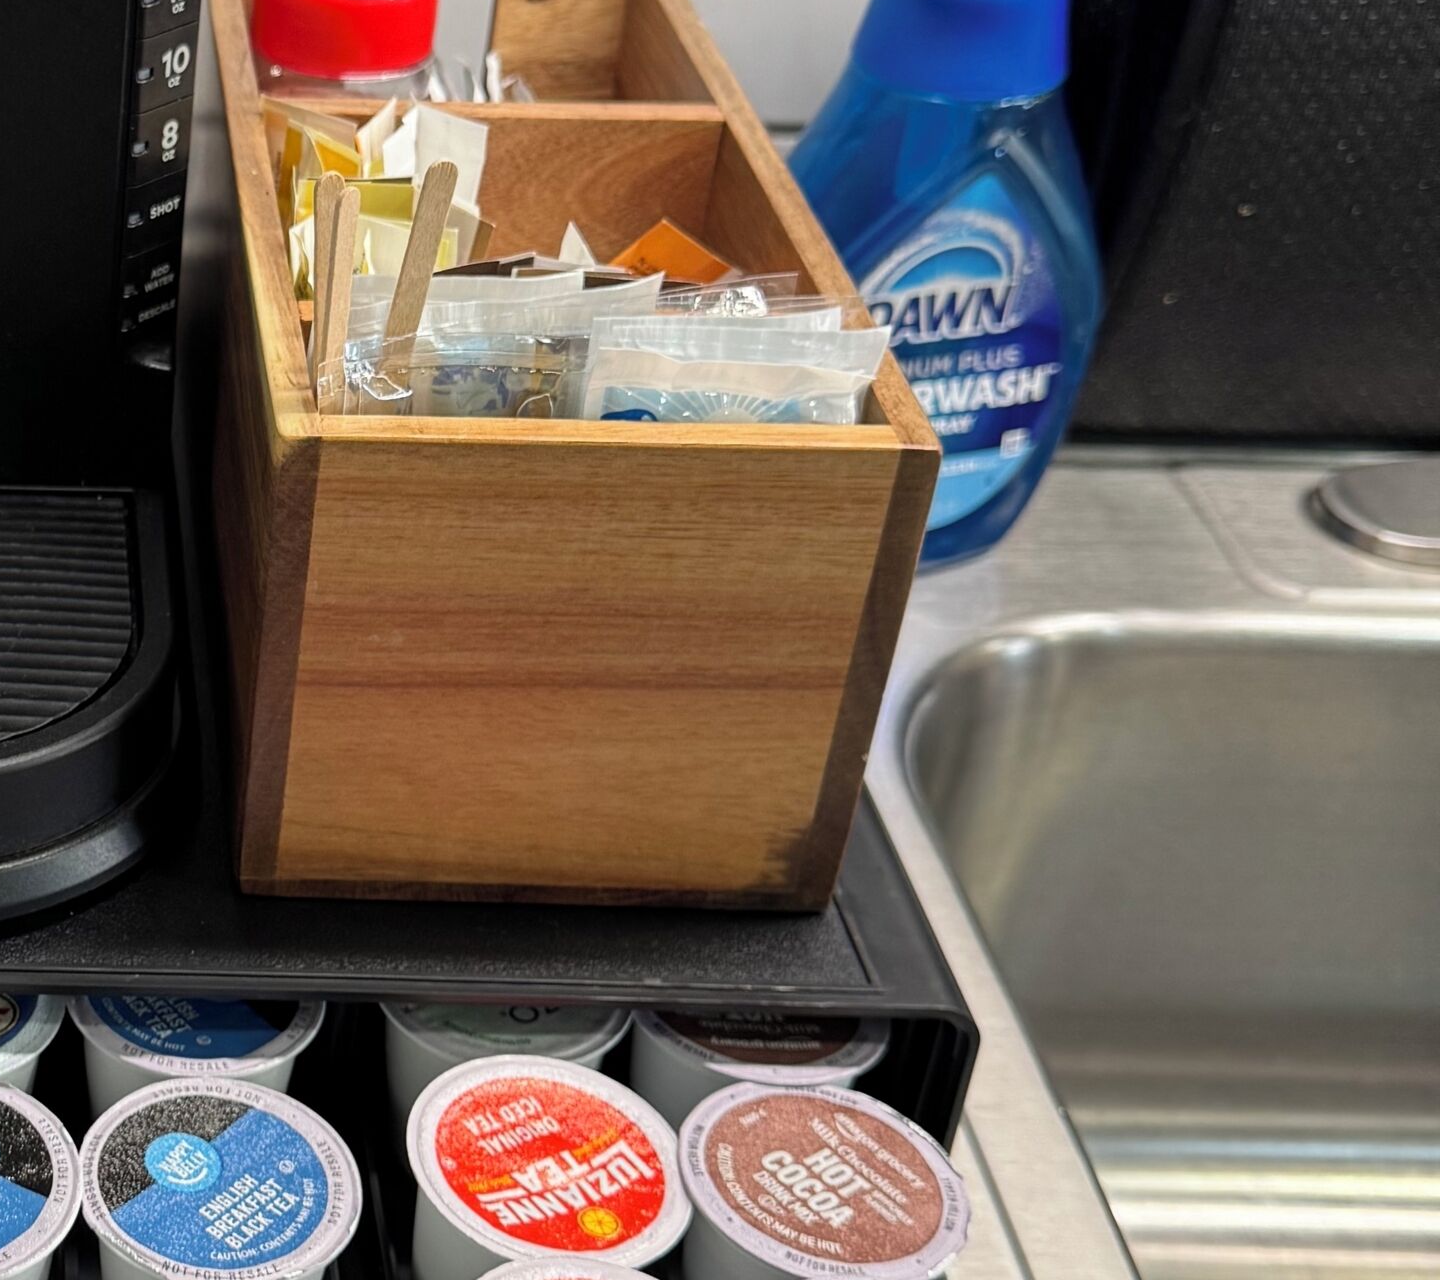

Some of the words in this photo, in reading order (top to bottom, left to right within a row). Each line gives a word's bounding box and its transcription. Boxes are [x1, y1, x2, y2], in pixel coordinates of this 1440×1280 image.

[162, 45, 190, 78] 10
[162, 121, 178, 149] 8
[150, 196, 181, 219] SHOT
[144, 273, 174, 293] WATER
[138, 299, 176, 322] DESCALE
[463, 1112, 502, 1136] TEA
[498, 1096, 543, 1120] ICED
[477, 1114, 562, 1157] ORIGINAL
[156, 1140, 194, 1170] HAPPY
[175, 1151, 208, 1179] BELLY
[512, 1150, 591, 1192] TEA
[480, 1139, 657, 1227] LUZIANNE
[762, 1149, 856, 1229] COCOA
[803, 1146, 871, 1200] HOT
[198, 1173, 259, 1221] ENGLISH
[205, 1178, 284, 1240] BREAKFAST
[224, 1215, 274, 1251] BLACK
[266, 1192, 301, 1219] TEA
